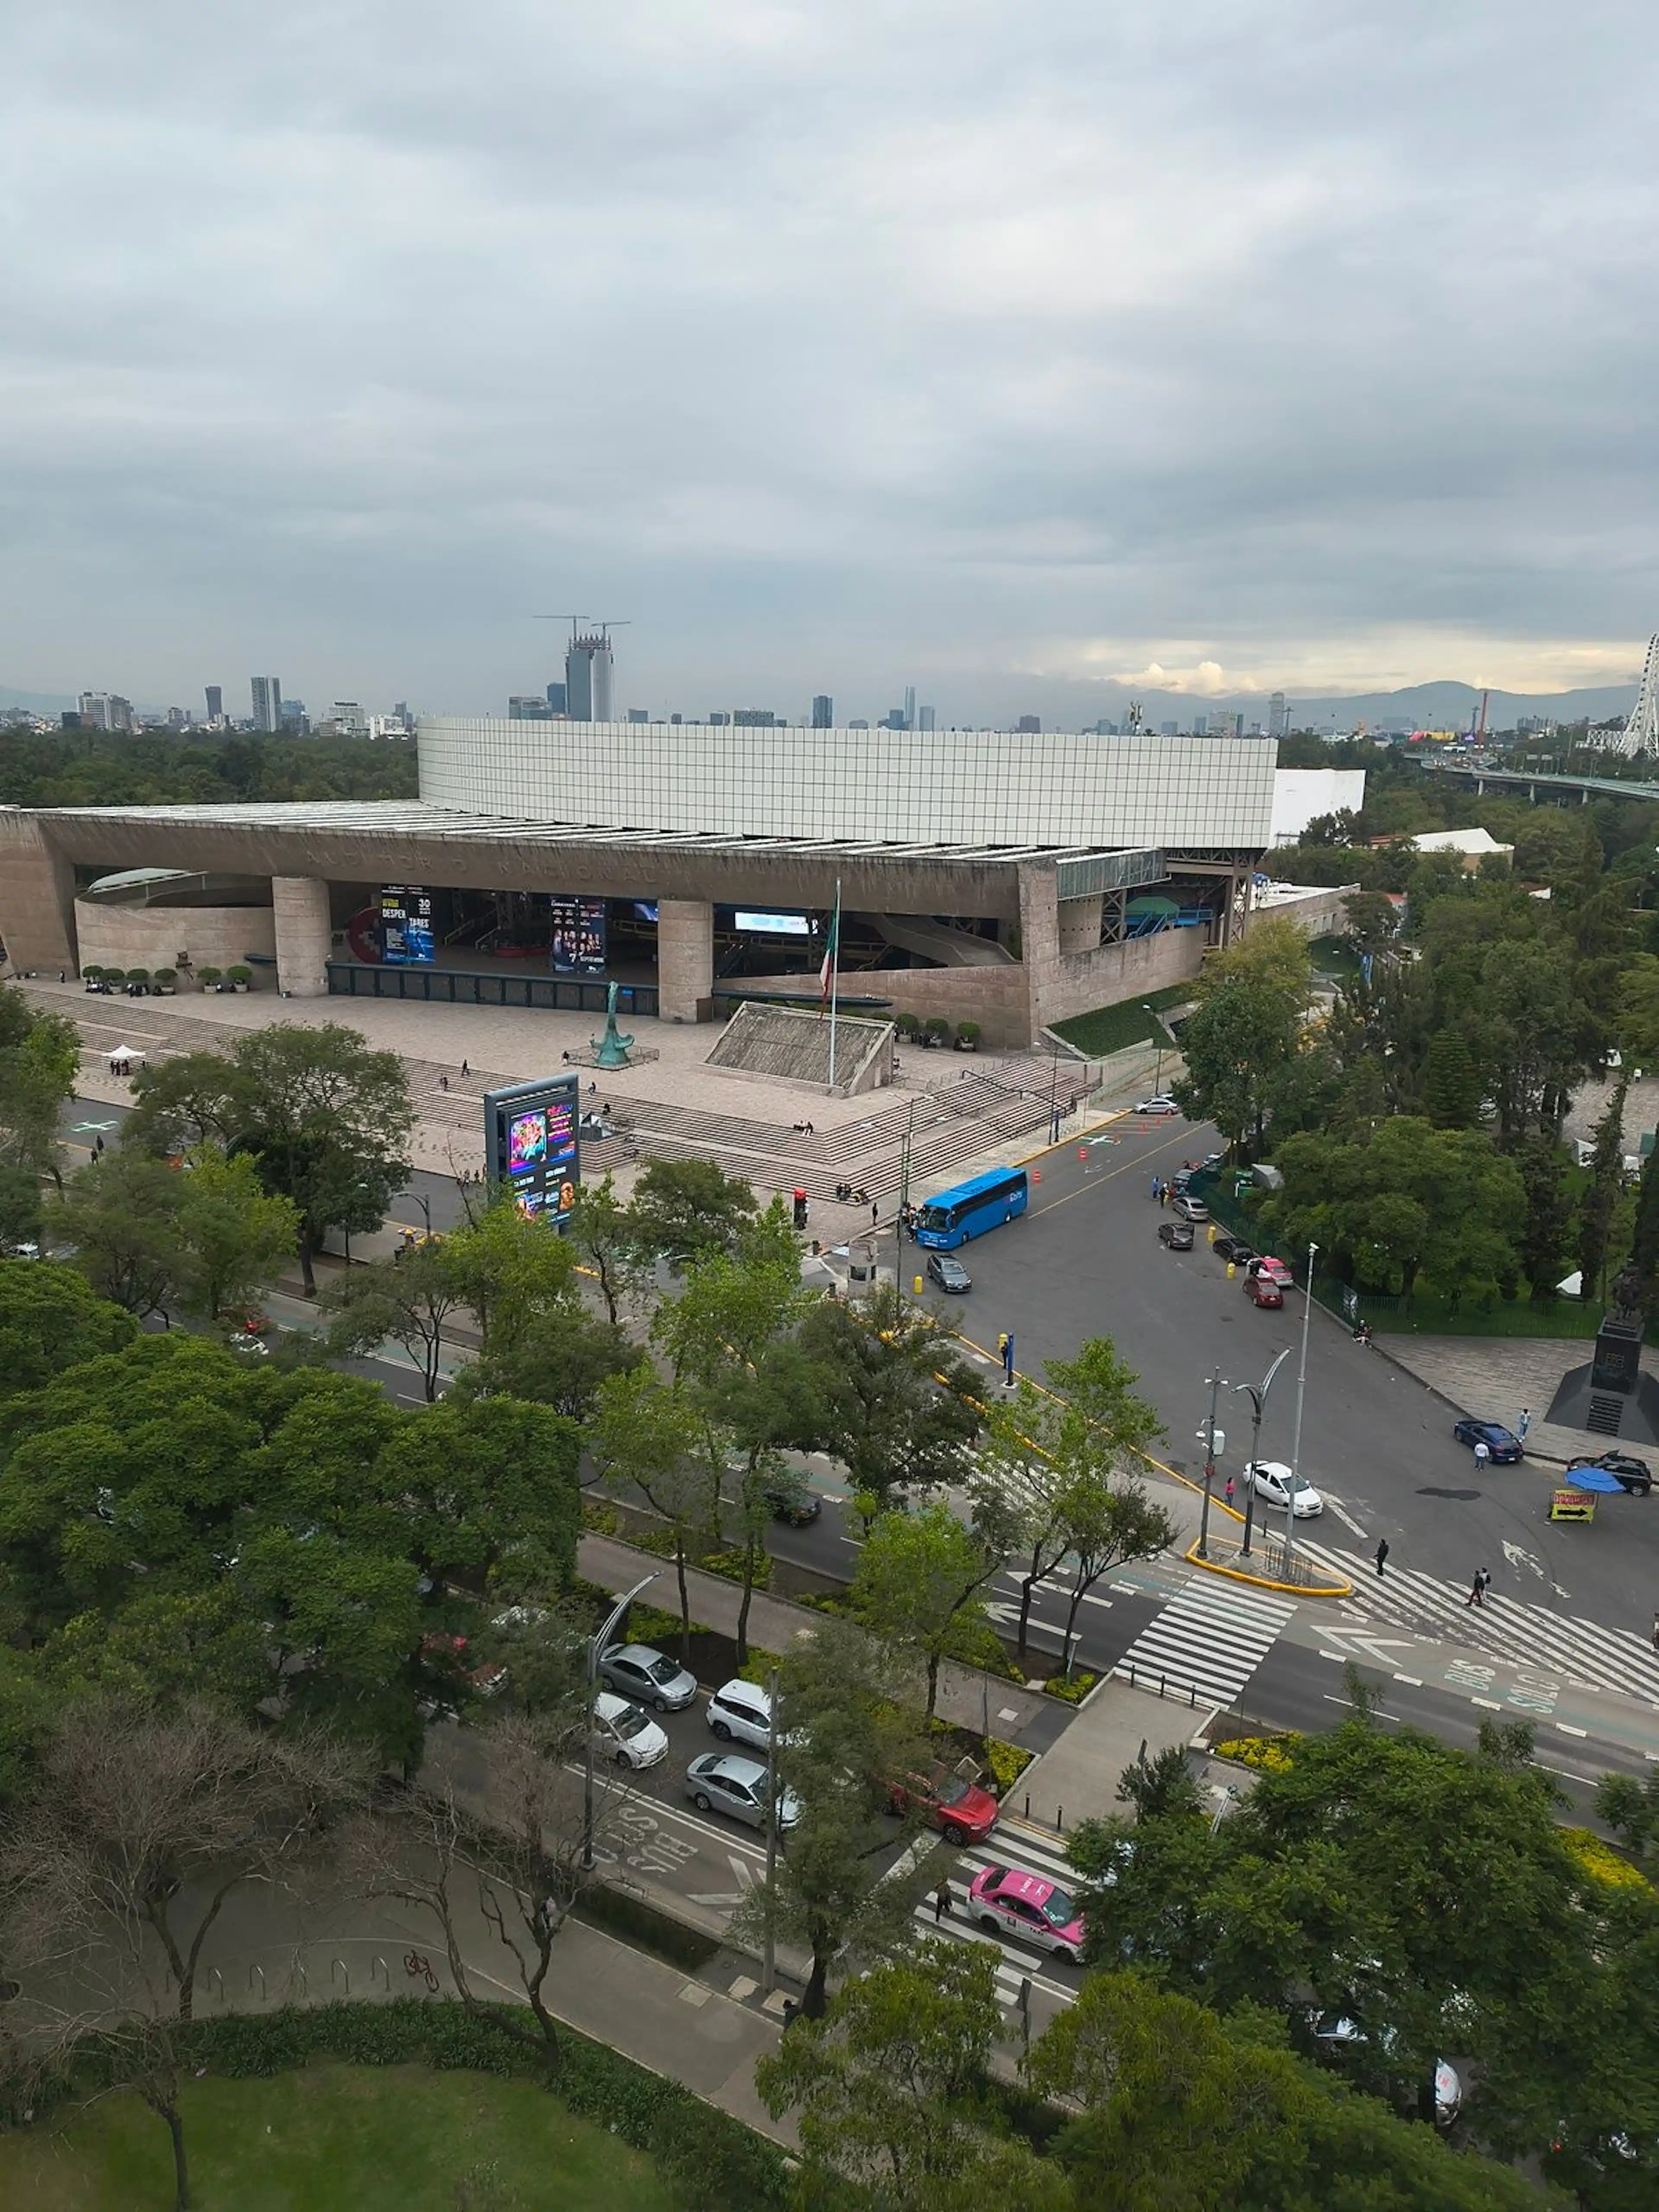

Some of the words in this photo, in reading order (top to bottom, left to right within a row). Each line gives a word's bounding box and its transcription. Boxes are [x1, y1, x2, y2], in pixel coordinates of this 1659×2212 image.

[418, 898, 431, 908] 30
[1444, 1658, 1496, 1691] BUS
[1506, 1674, 1560, 1713] SOLO
[626, 1832, 699, 1872] BUS
